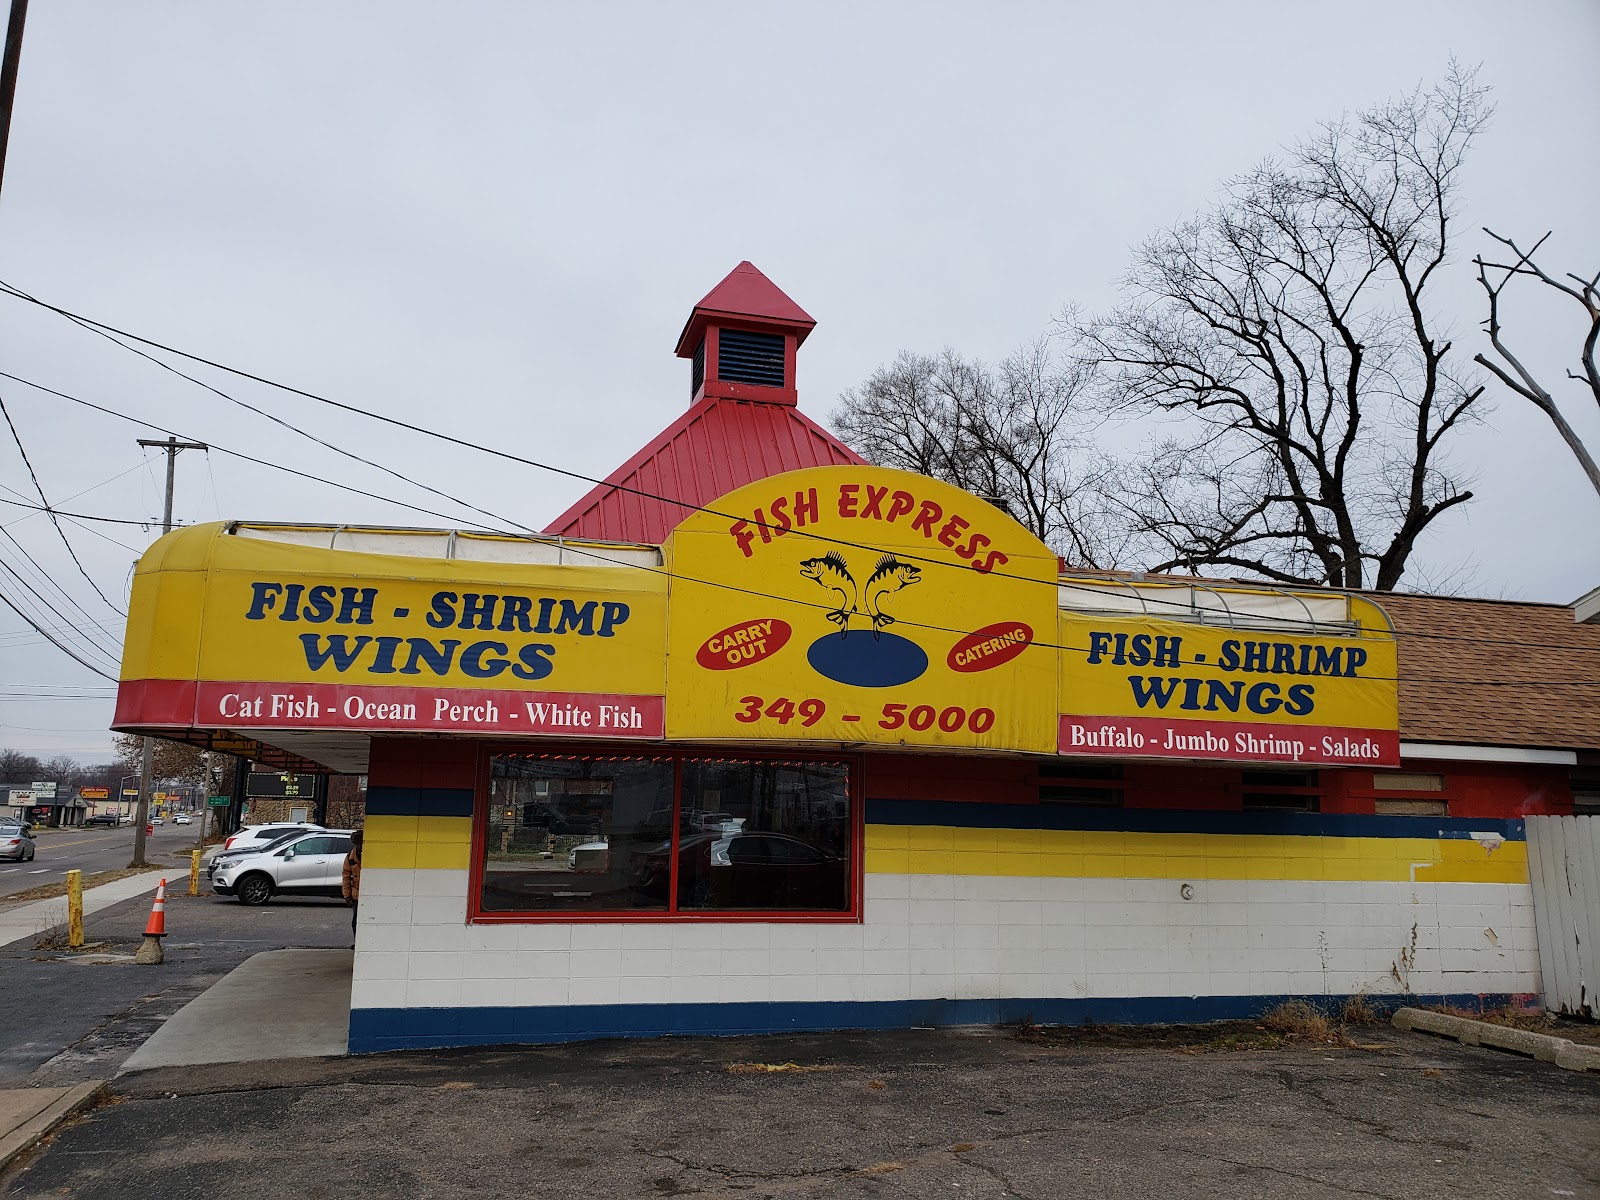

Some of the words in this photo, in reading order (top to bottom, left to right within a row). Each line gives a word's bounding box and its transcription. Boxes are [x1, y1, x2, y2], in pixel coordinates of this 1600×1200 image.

[729, 487, 820, 558] FISH
[837, 484, 1009, 575] EXPRESS
[245, 582, 378, 625] FISH
[426, 591, 630, 637] SHRIMP
[299, 633, 555, 680] WINGS
[708, 620, 773, 654] CARRY
[726, 639, 768, 664] OUT
[954, 628, 1026, 667] CATERING
[1087, 631, 1182, 669] FISH
[1218, 639, 1367, 678] SHRIMP
[219, 694, 264, 719] Cat
[269, 694, 320, 719] Fish
[343, 695, 416, 721] Ocean
[432, 698, 499, 723] Perch
[525, 702, 592, 727] White
[598, 705, 643, 729] Fish
[734, 695, 826, 728] 349
[878, 703, 996, 734] 5000
[1127, 675, 1315, 716] WINGS
[1070, 724, 1145, 749] Buffalo
[1163, 728, 1230, 752] Jumbo
[1235, 732, 1304, 762] Shrimp
[1322, 735, 1380, 759] Salads
